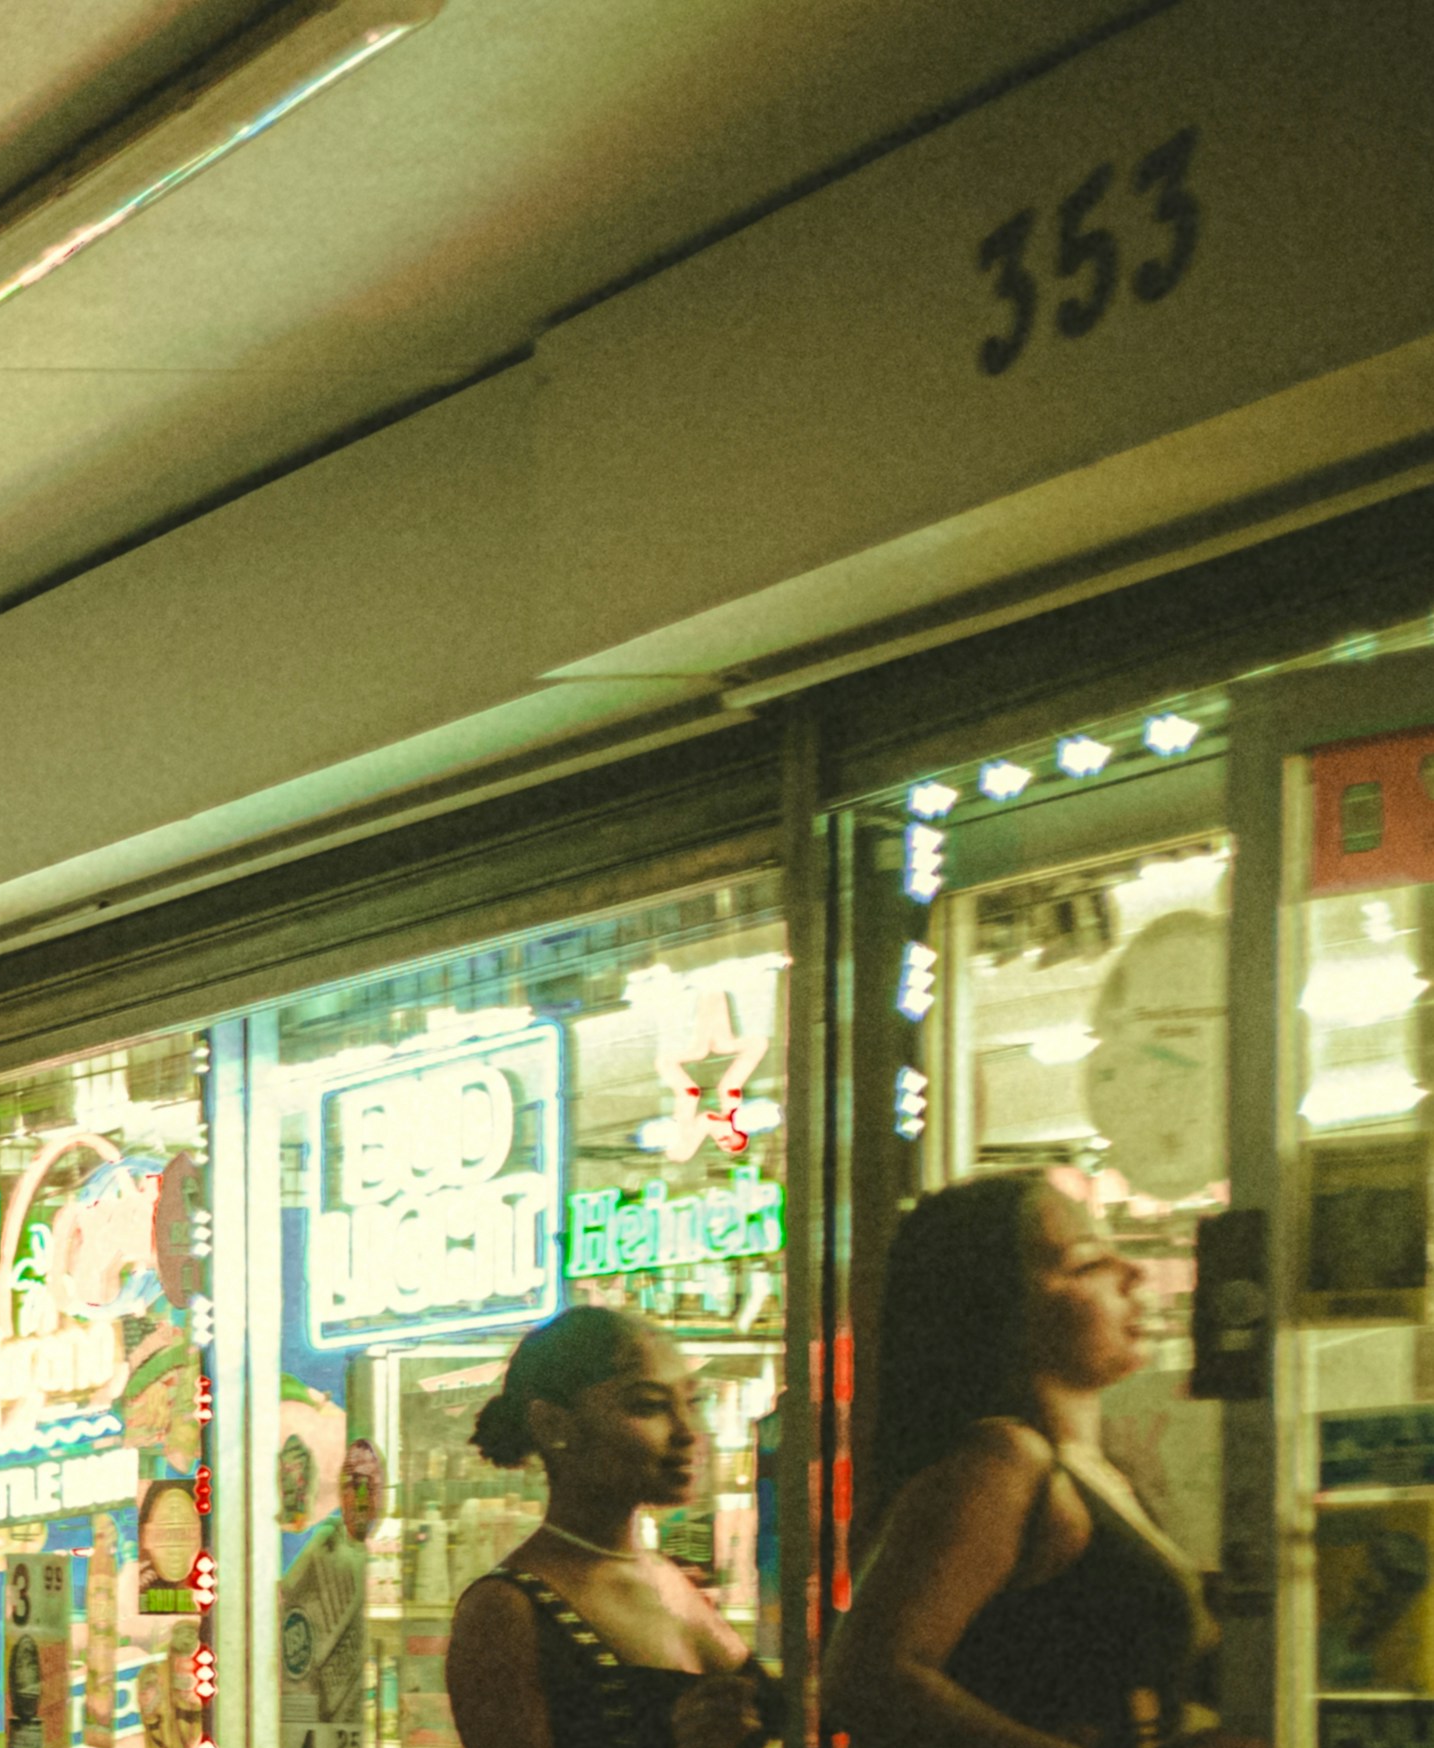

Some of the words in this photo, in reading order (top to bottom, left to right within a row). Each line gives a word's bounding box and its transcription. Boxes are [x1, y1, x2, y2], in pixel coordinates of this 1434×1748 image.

[975, 125, 1200, 377] 353
[341, 1064, 514, 1206] BUD
[308, 1170, 546, 1318] LIGHT
[12, 1563, 31, 1627] 3
